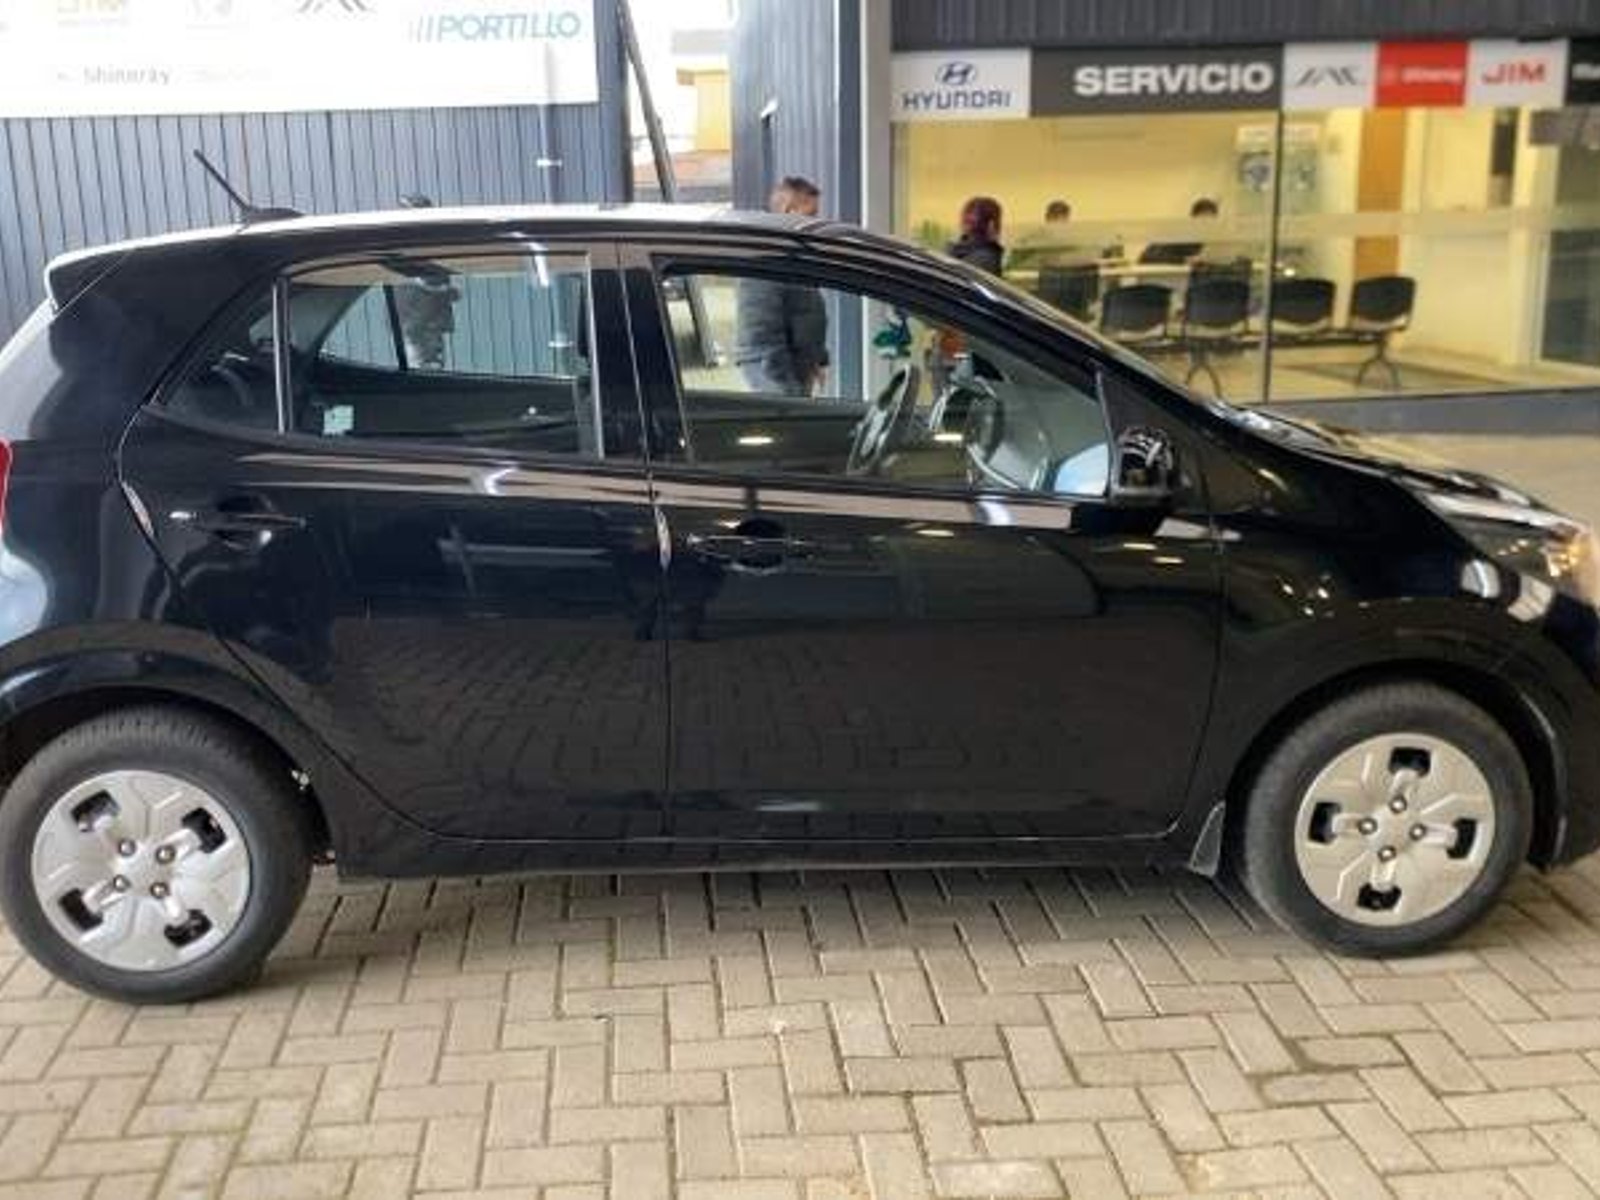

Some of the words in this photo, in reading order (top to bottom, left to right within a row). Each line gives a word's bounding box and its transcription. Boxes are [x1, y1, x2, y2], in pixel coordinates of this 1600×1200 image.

[437, 11, 582, 43] PORTILLO
[1073, 62, 1274, 97] SERVICIO
[901, 88, 1011, 111] HYUNDAI
